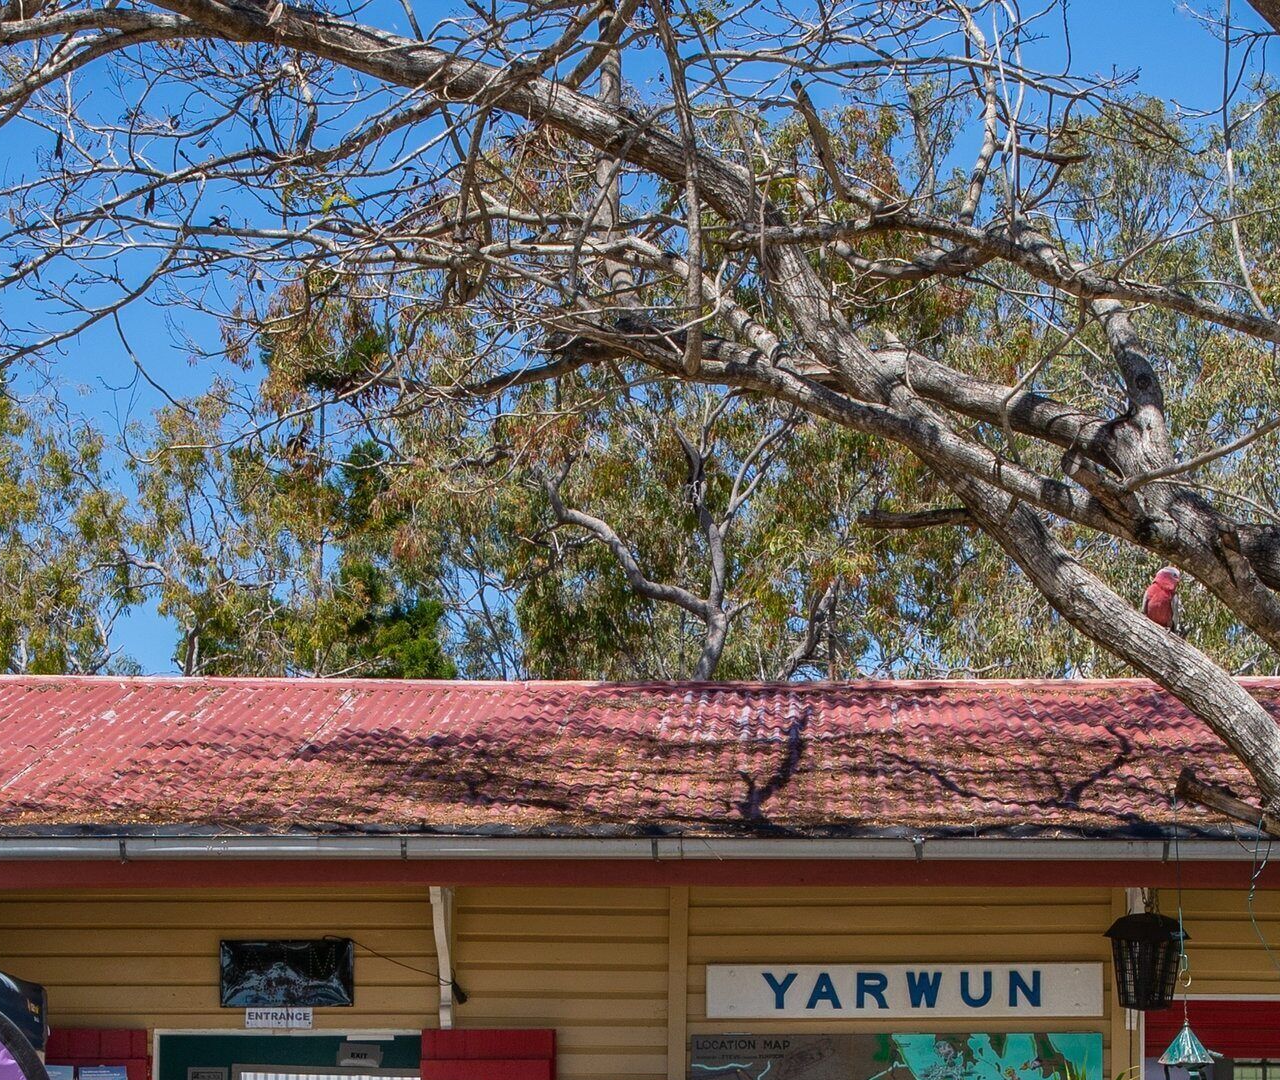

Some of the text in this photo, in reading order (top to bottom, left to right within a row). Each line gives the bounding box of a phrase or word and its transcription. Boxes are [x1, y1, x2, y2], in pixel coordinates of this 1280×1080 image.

[762, 969, 1042, 1011] YARWUN
[247, 1011, 311, 1022] ENTRANCE
[695, 1039, 791, 1050] LOCATION MAP
[350, 1052, 368, 1060] EXIT
